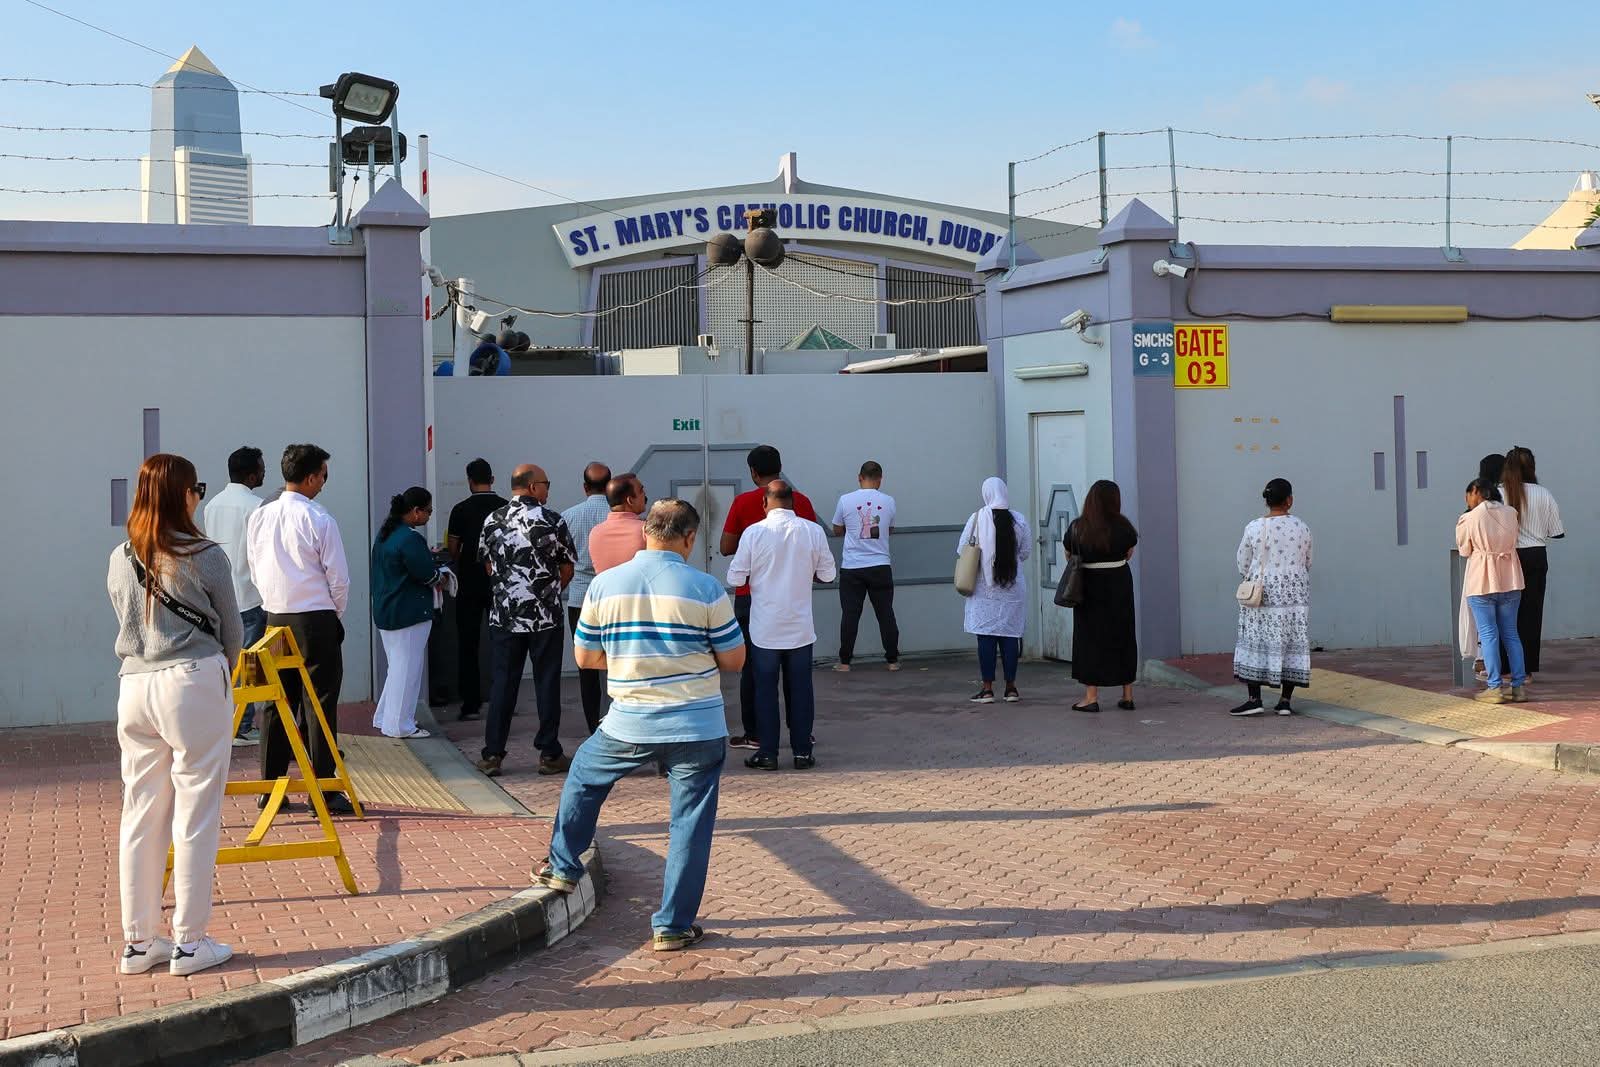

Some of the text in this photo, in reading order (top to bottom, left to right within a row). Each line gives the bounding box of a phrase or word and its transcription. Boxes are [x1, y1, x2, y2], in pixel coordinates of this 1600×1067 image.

[569, 203, 1003, 257] ST. MARY'S CAOLIC CHURCH, DUBA
[1134, 333, 1174, 348] SMCHS
[1175, 329, 1225, 357] GATE
[1187, 361, 1217, 385] 03
[673, 418, 700, 431] Exit
[177, 606, 202, 623] bebe
